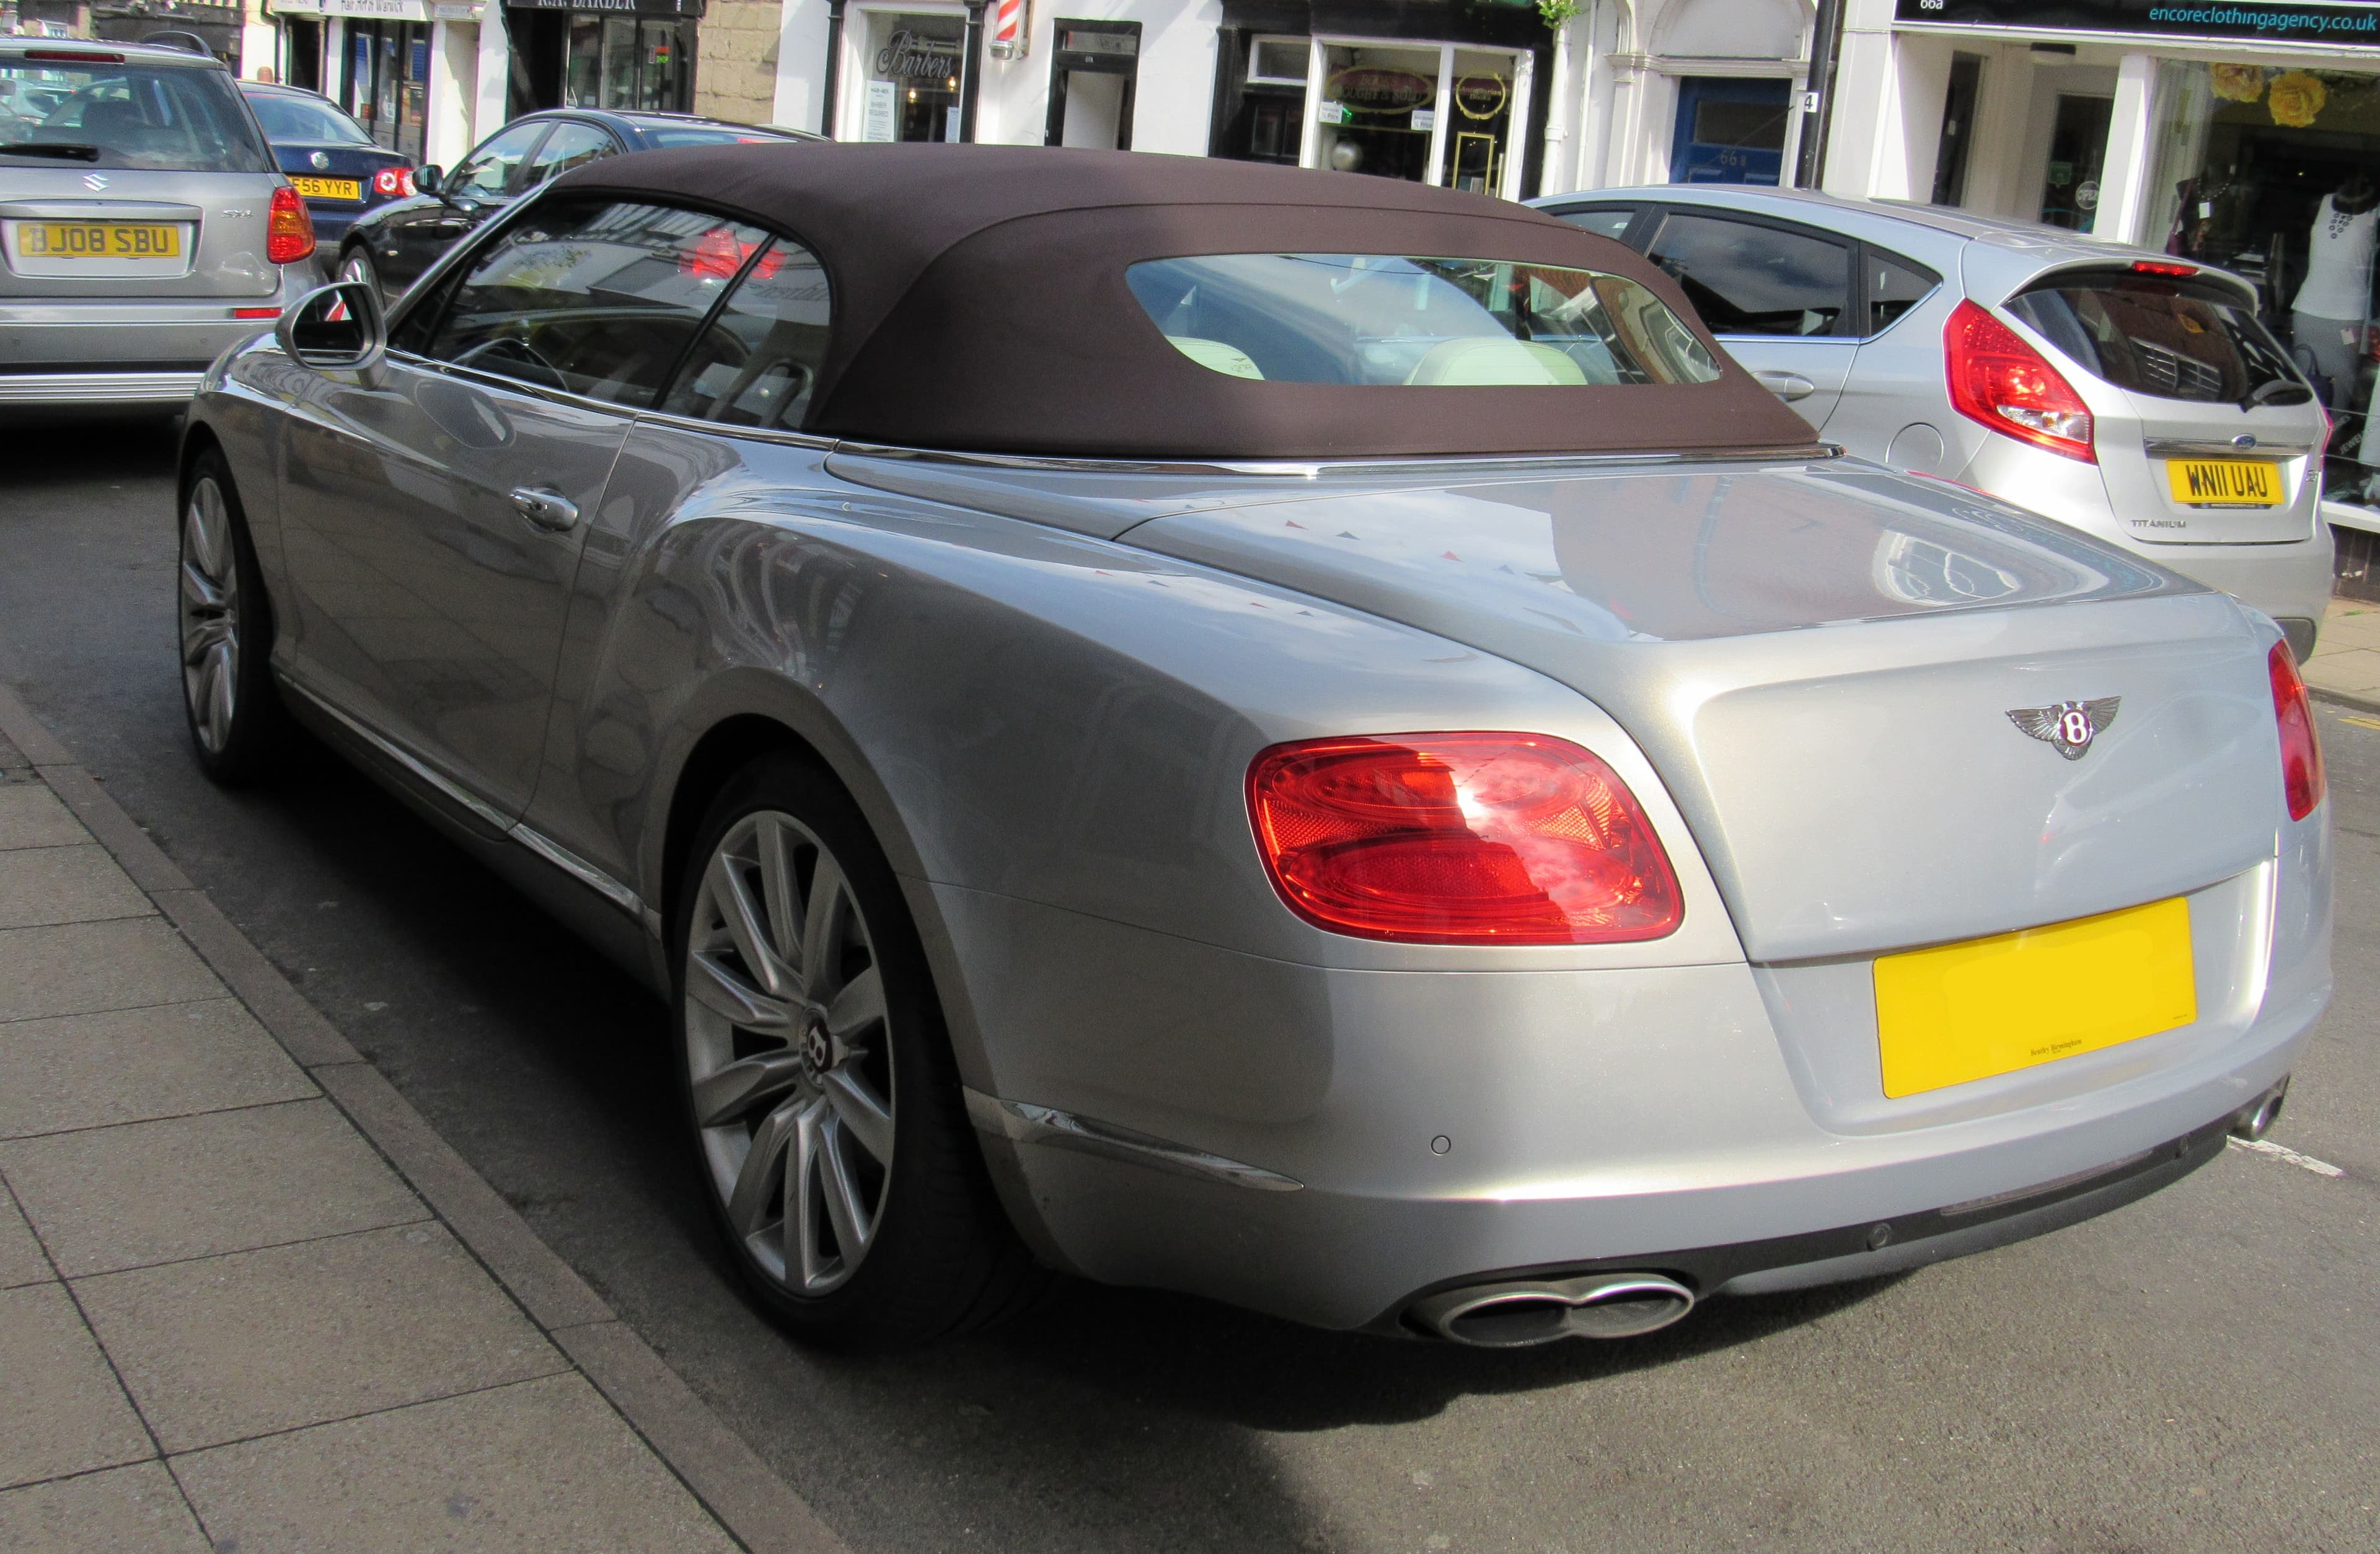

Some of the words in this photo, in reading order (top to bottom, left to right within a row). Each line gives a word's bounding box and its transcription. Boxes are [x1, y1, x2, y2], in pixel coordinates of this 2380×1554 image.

[2149, 7, 2376, 32] encoreclothingagency.co.uk
[876, 29, 952, 79] Barbers
[1804, 94, 1814, 110] 4
[325, 181, 351, 196] YYR
[30, 227, 106, 253] BJ08
[114, 228, 169, 253] SBU
[2185, 464, 2229, 497] WN11
[2230, 465, 2268, 498] UAU
[2130, 519, 2186, 528] TITANIUM
